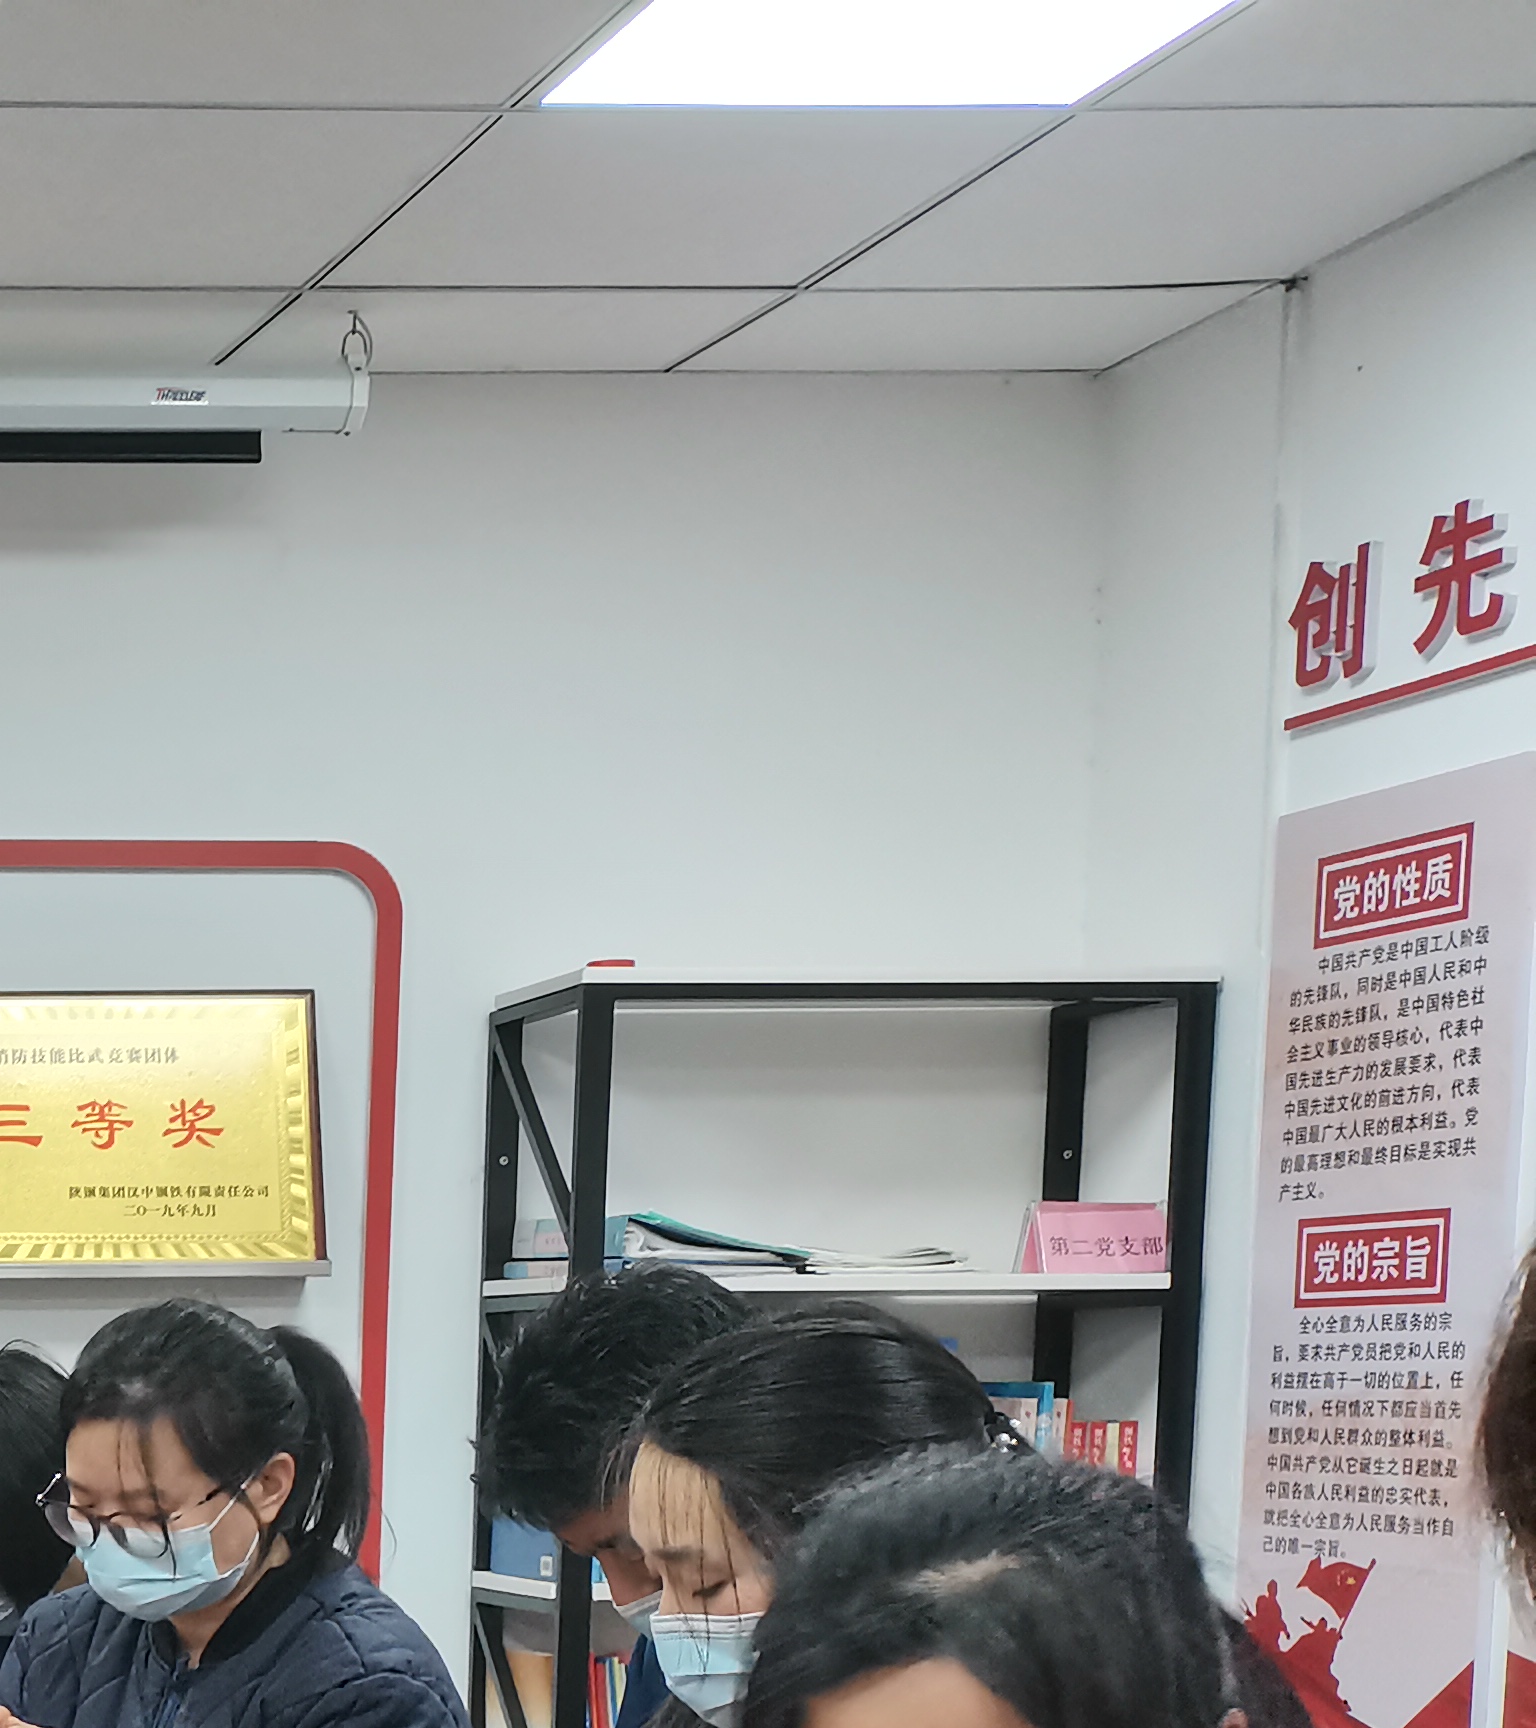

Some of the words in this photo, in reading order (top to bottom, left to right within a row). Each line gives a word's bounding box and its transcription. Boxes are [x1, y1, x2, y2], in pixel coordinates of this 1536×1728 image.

[1288, 500, 1506, 687] 创先
[1333, 853, 1454, 922] 党的性质
[1318, 925, 1490, 975] 中国共产党是中国工人阶级
[1290, 955, 1488, 1008] 的先锋队，同时是中国人民和中
[1288, 985, 1486, 1036] 华民族的先锋队，是中国特色社
[1278, 1182, 1325, 1203] 产主义。
[1049, 1235, 1164, 1257] 第二党支部
[1312, 1234, 1432, 1285] 党的宗旨
[1298, 1312, 1453, 1335] 全心全意为人民服务的宗
